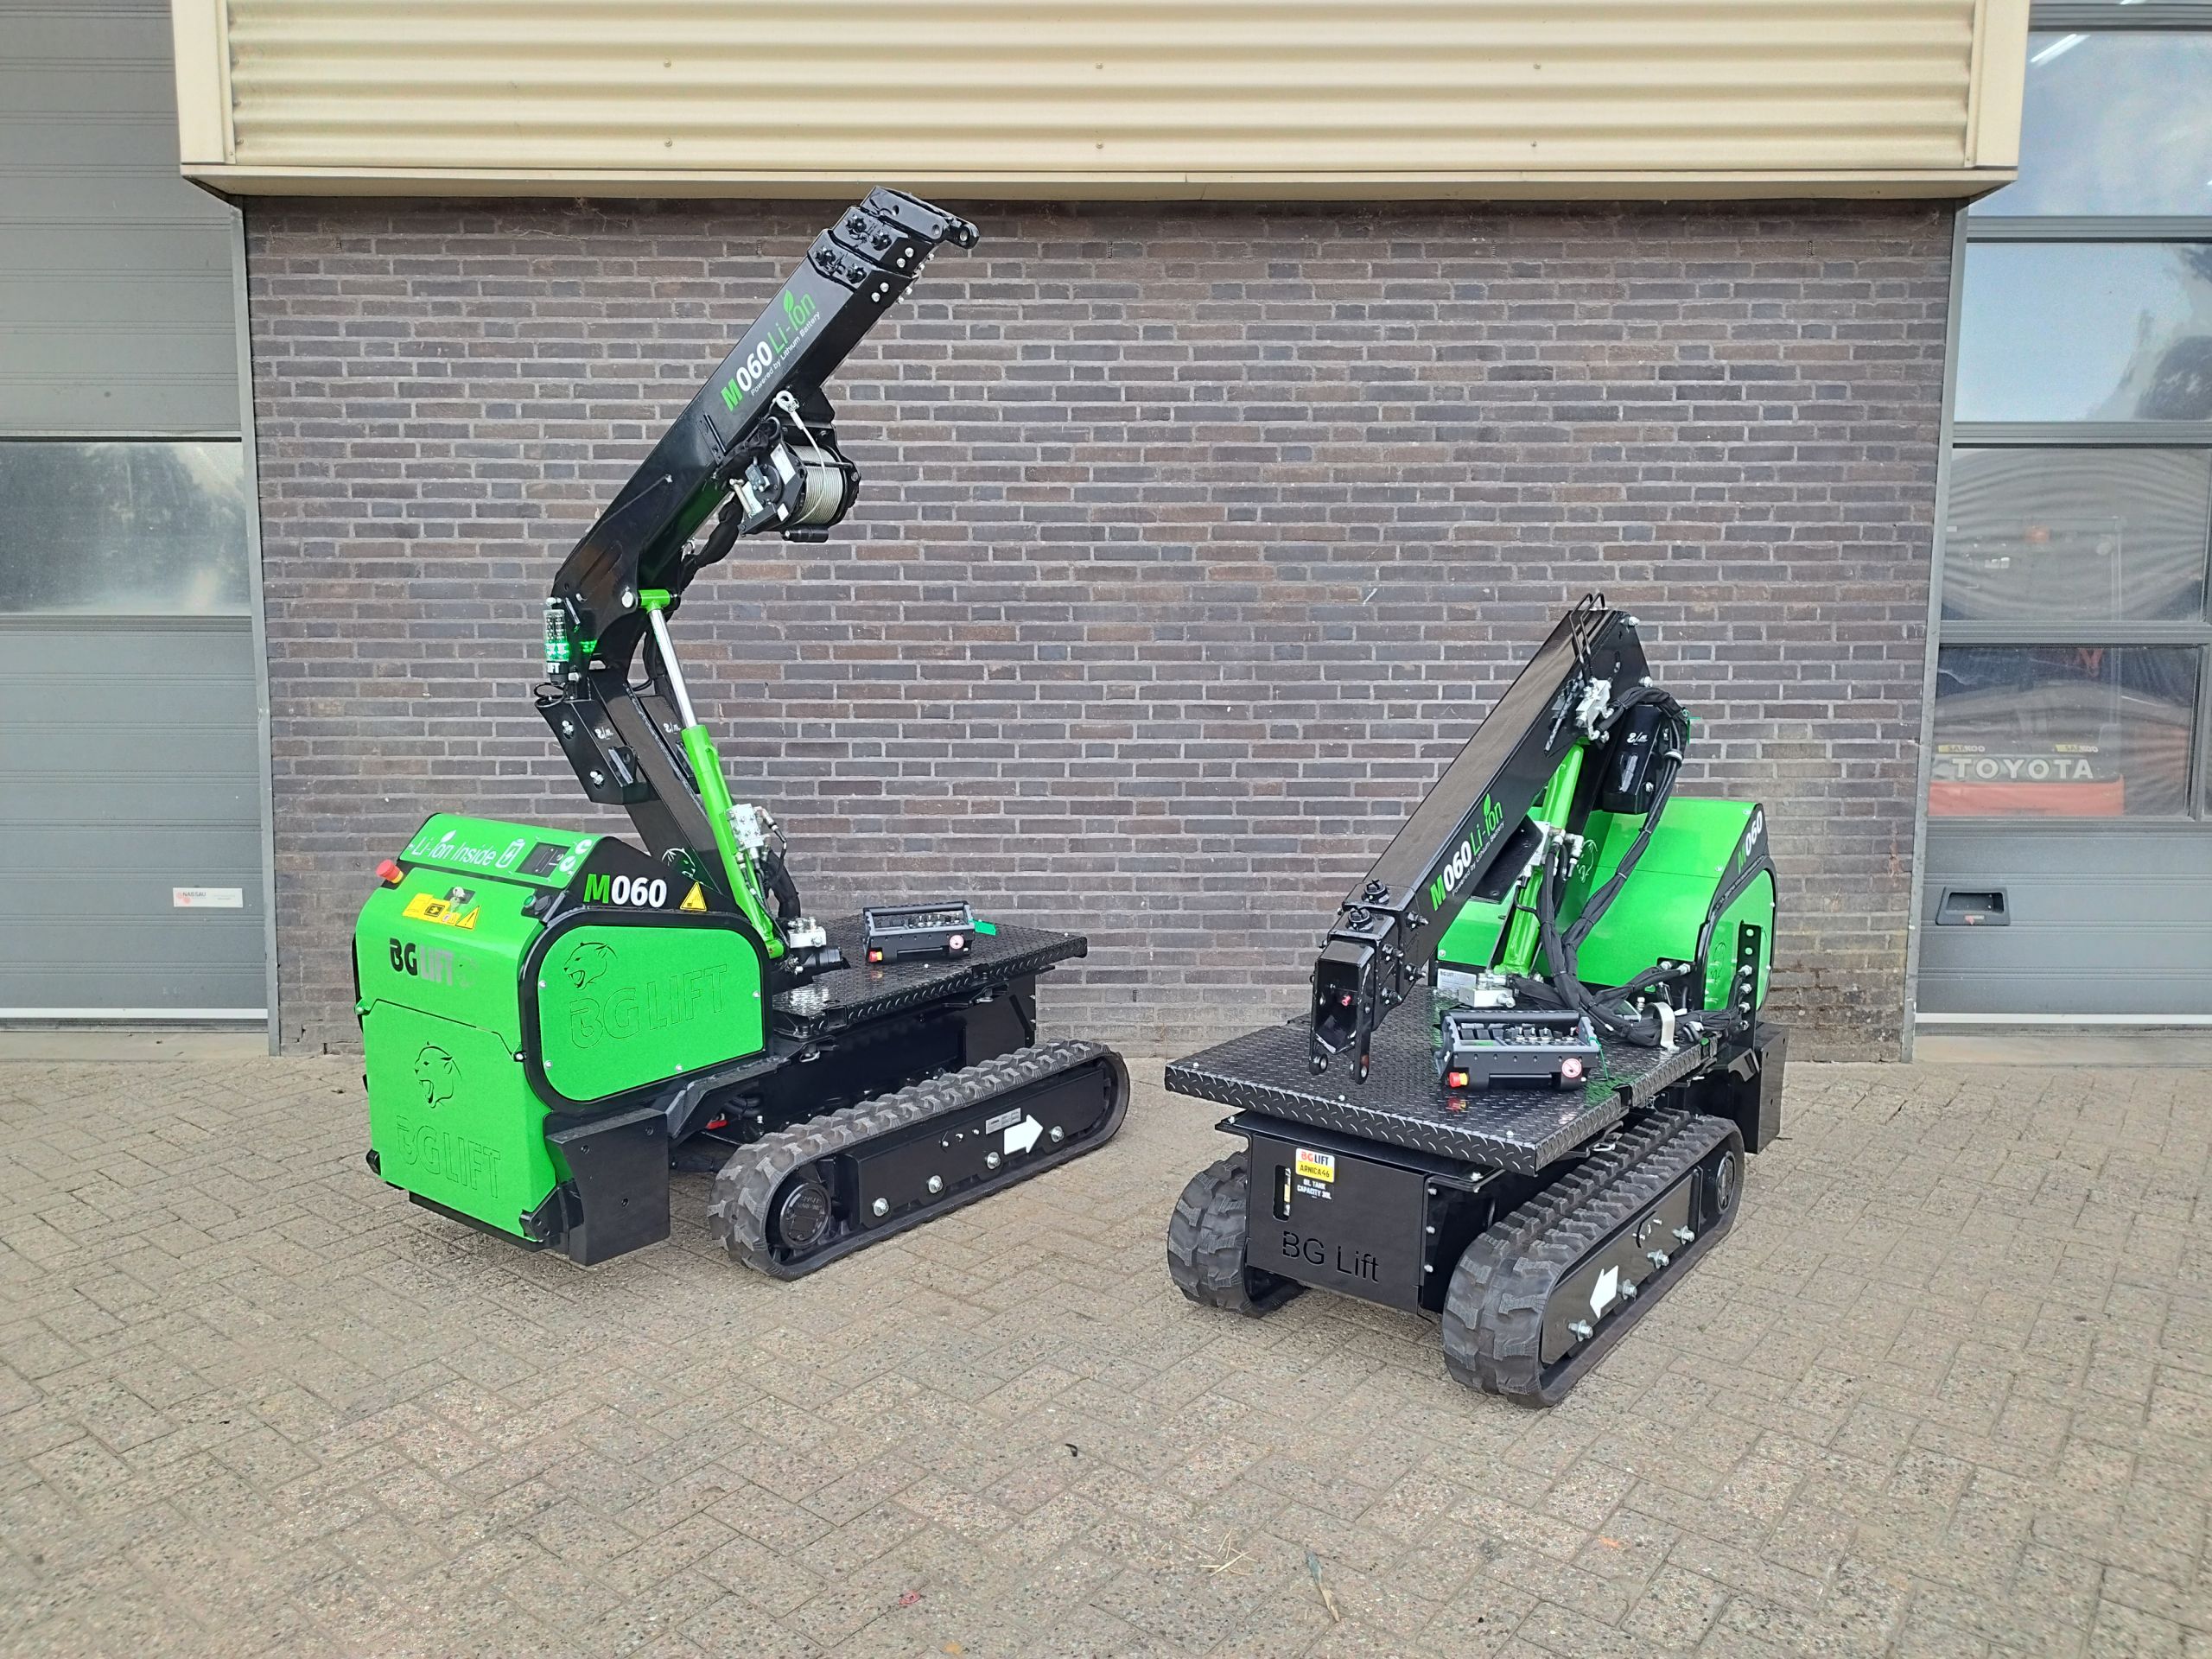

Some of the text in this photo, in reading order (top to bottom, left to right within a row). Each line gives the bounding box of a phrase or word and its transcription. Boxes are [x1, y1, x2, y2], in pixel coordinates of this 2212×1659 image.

[721, 341, 772, 411] M060
[750, 311, 821, 397] Powered by Lithium Battery
[1951, 758, 2094, 779] TOYOTA
[452, 842, 497, 867] Inside
[1738, 810, 1763, 875] M060
[582, 874, 667, 908] M060
[1429, 840, 1472, 912] M060
[1282, 1230, 1379, 1283] BG Lift
